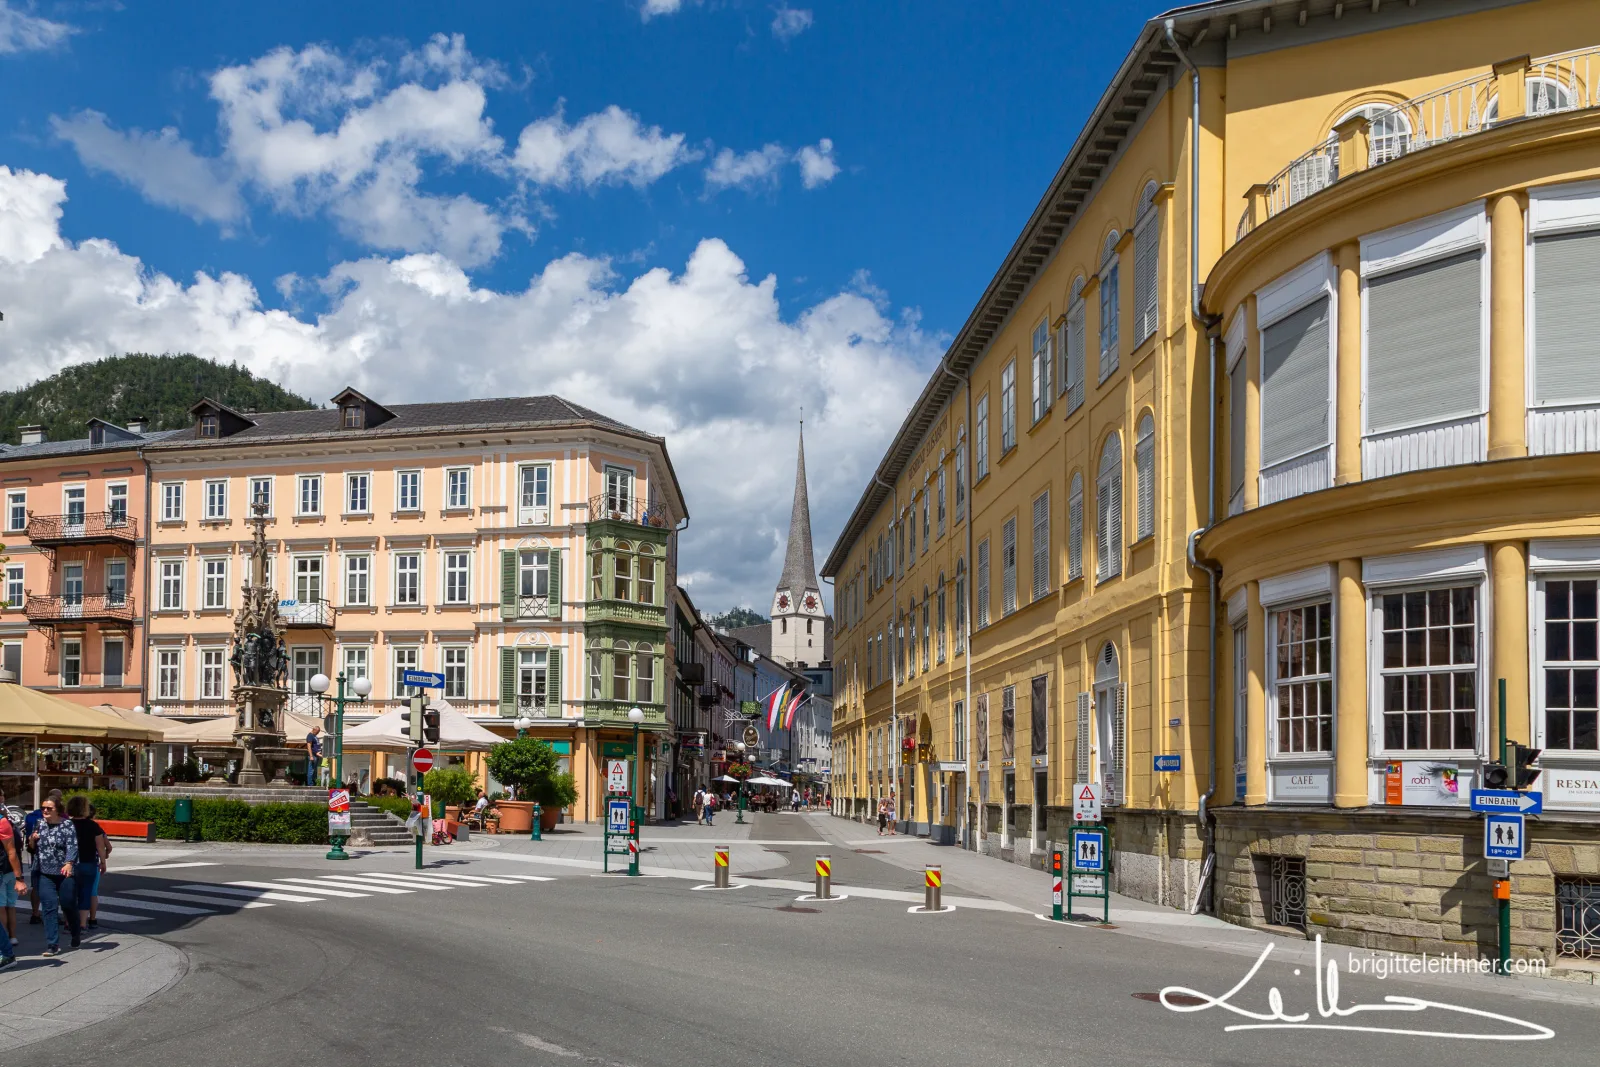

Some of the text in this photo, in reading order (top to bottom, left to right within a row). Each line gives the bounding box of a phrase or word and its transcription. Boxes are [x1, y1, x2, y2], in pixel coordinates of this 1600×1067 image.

[408, 675, 432, 683] EINBAHN
[1291, 772, 1314, 785] CAFÉ
[1411, 776, 1431, 785] roth
[1479, 796, 1518, 806] EINBAHN
